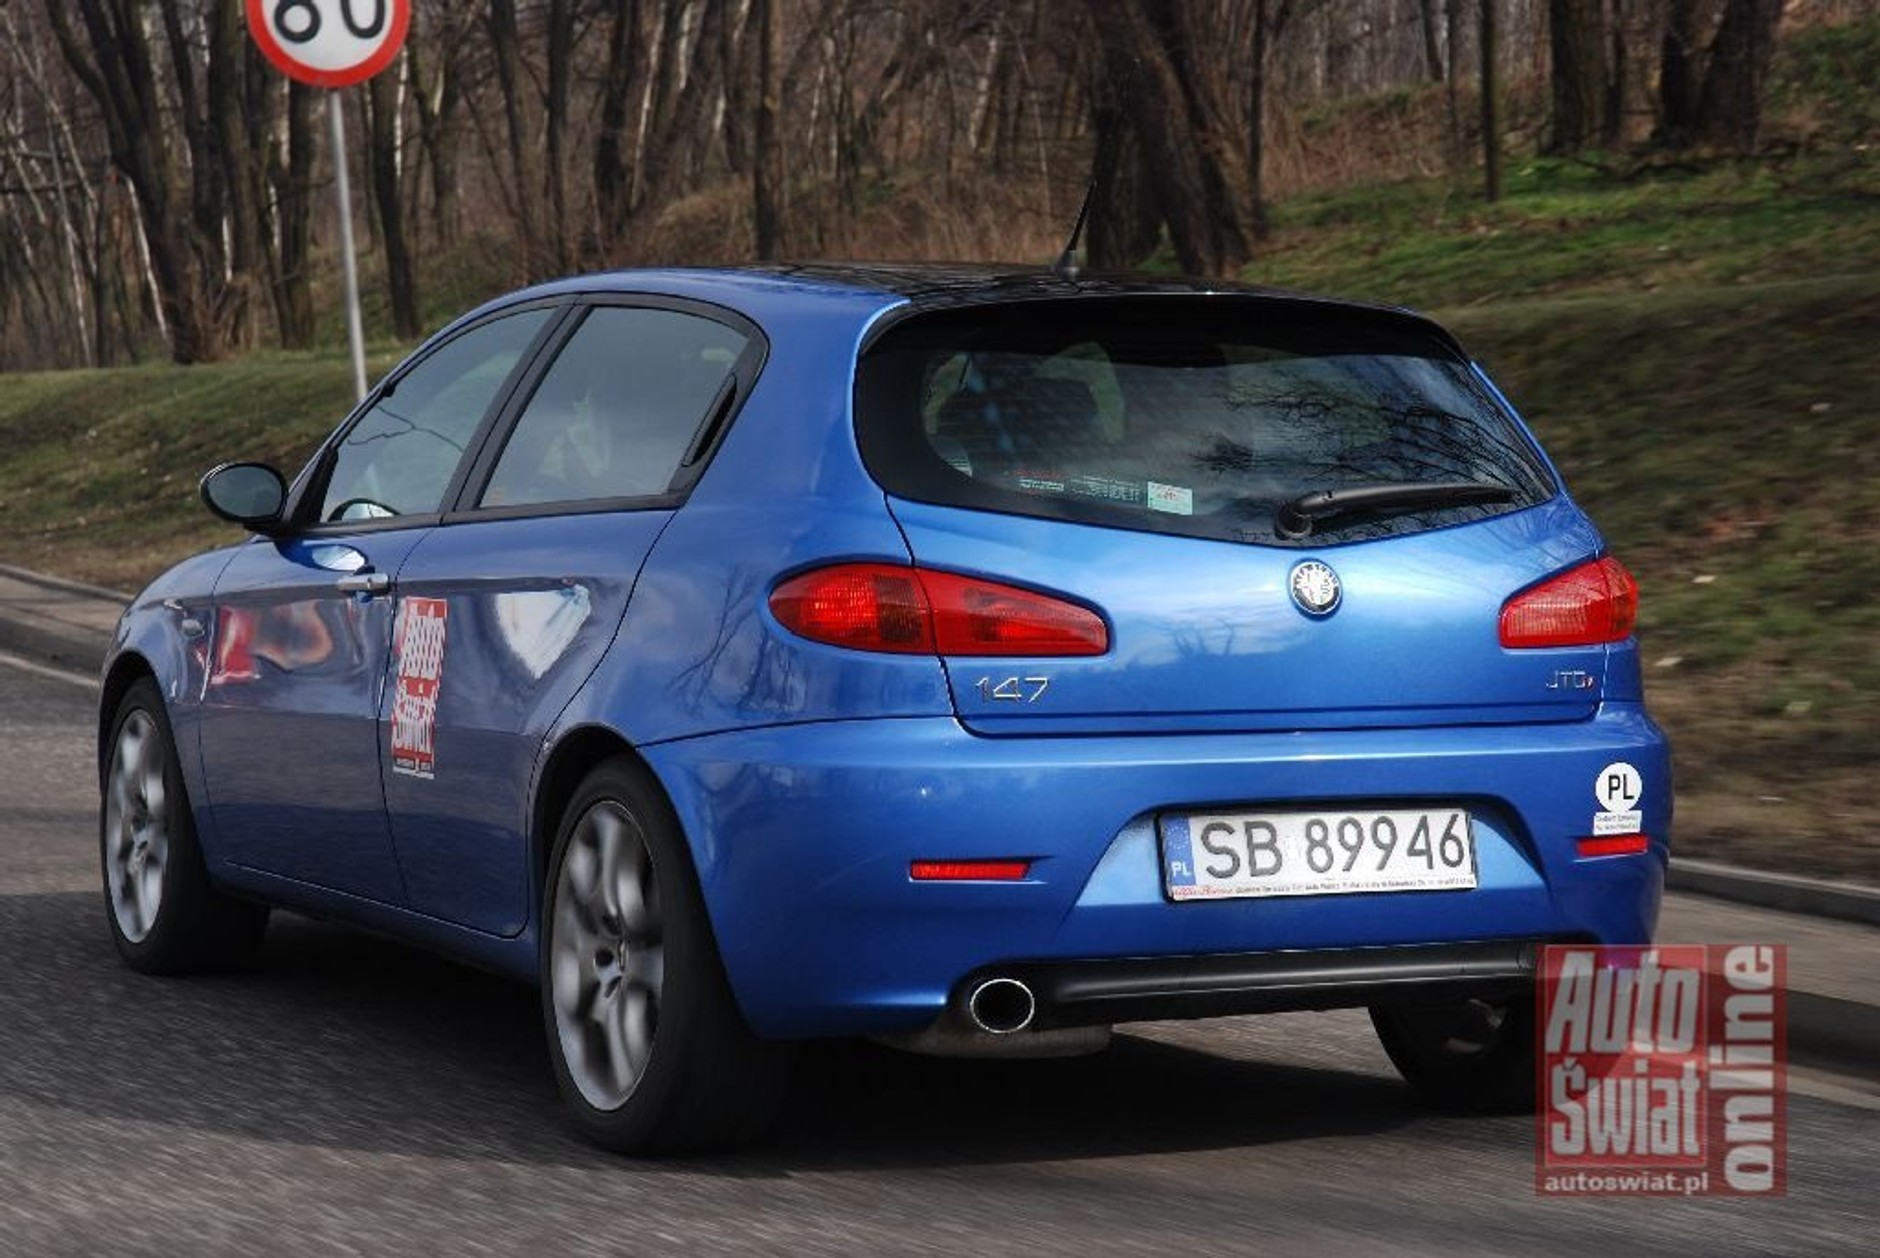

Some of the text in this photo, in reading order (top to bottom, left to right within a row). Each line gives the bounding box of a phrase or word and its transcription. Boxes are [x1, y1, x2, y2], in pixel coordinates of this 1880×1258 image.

[975, 677, 1049, 703] 147
[1607, 773, 1635, 800] PL
[1200, 813, 1465, 879] SB 89946
[1171, 861, 1192, 877] PL
